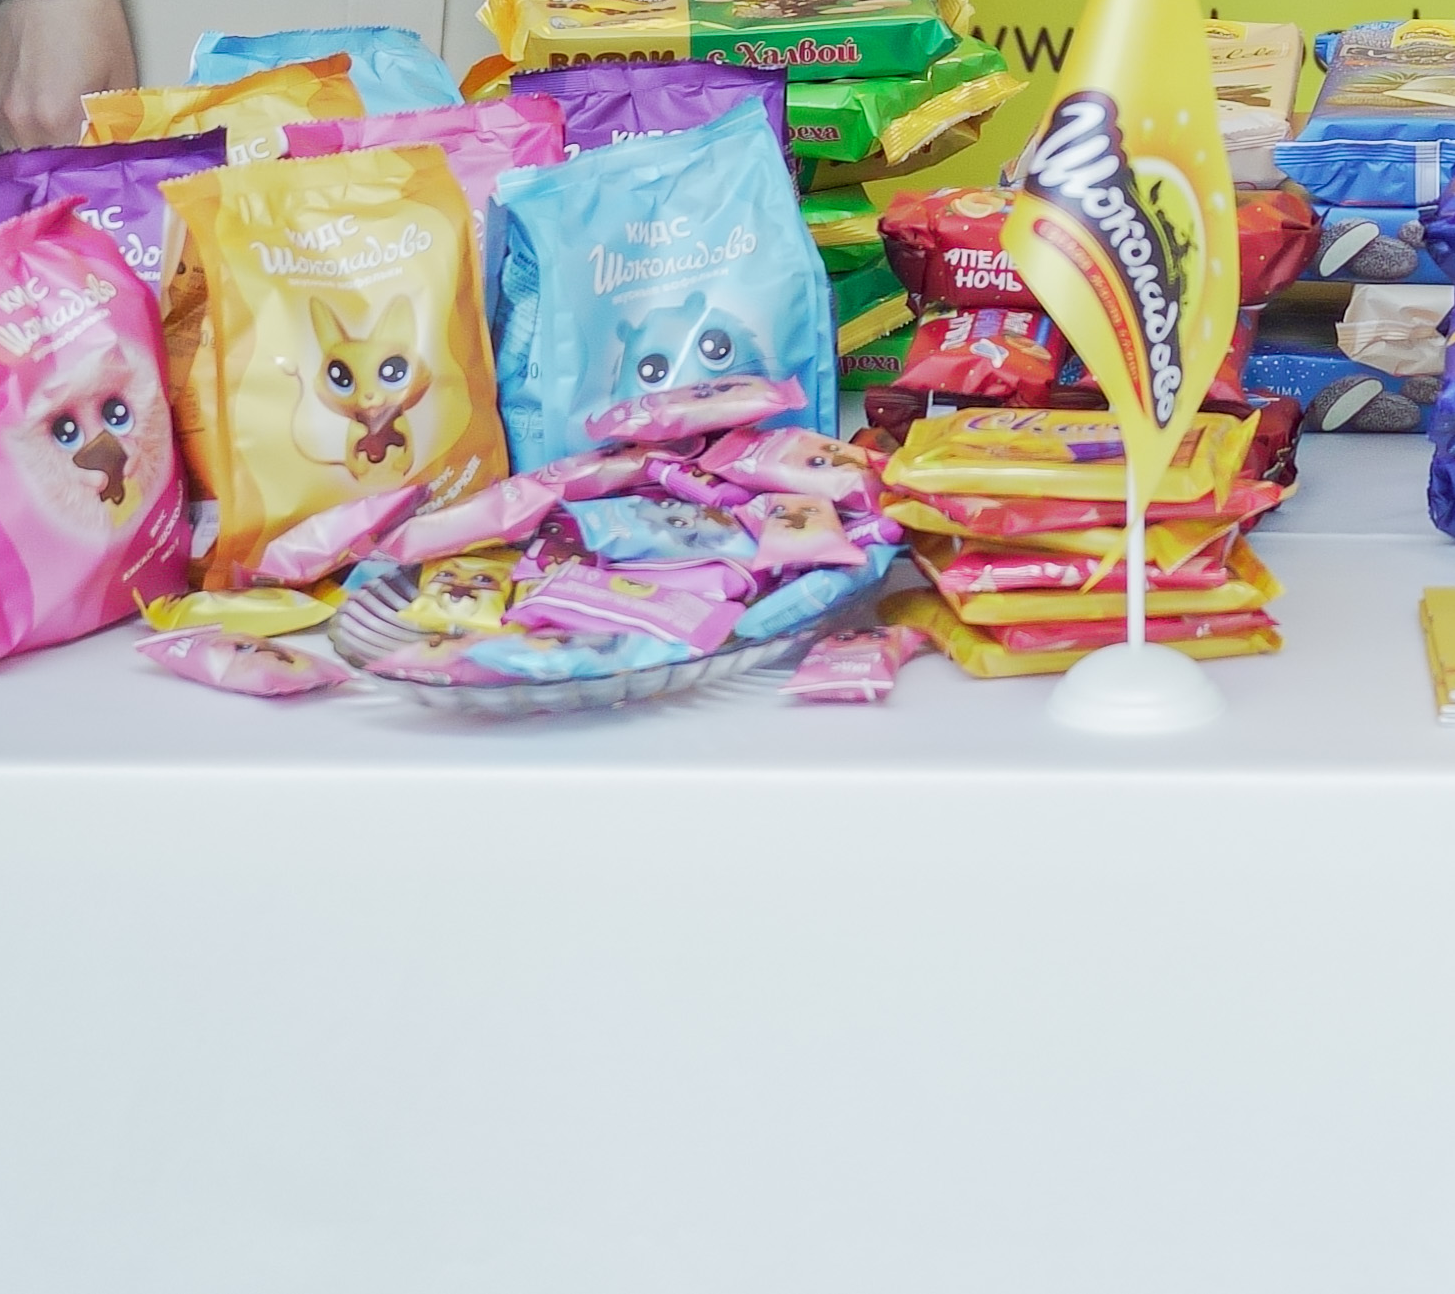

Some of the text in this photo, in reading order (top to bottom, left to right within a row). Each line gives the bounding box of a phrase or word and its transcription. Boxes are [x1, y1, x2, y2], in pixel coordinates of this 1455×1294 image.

[735, 37, 862, 68] Халвой
[625, 216, 691, 247] КИДС
[250, 223, 433, 276] Шоколадово
[588, 224, 757, 296] Шоколадово
[1029, 101, 1182, 422] Шоколадово
[954, 269, 1023, 292] НОЧЬ
[1267, 386, 1302, 396] ZIMA
